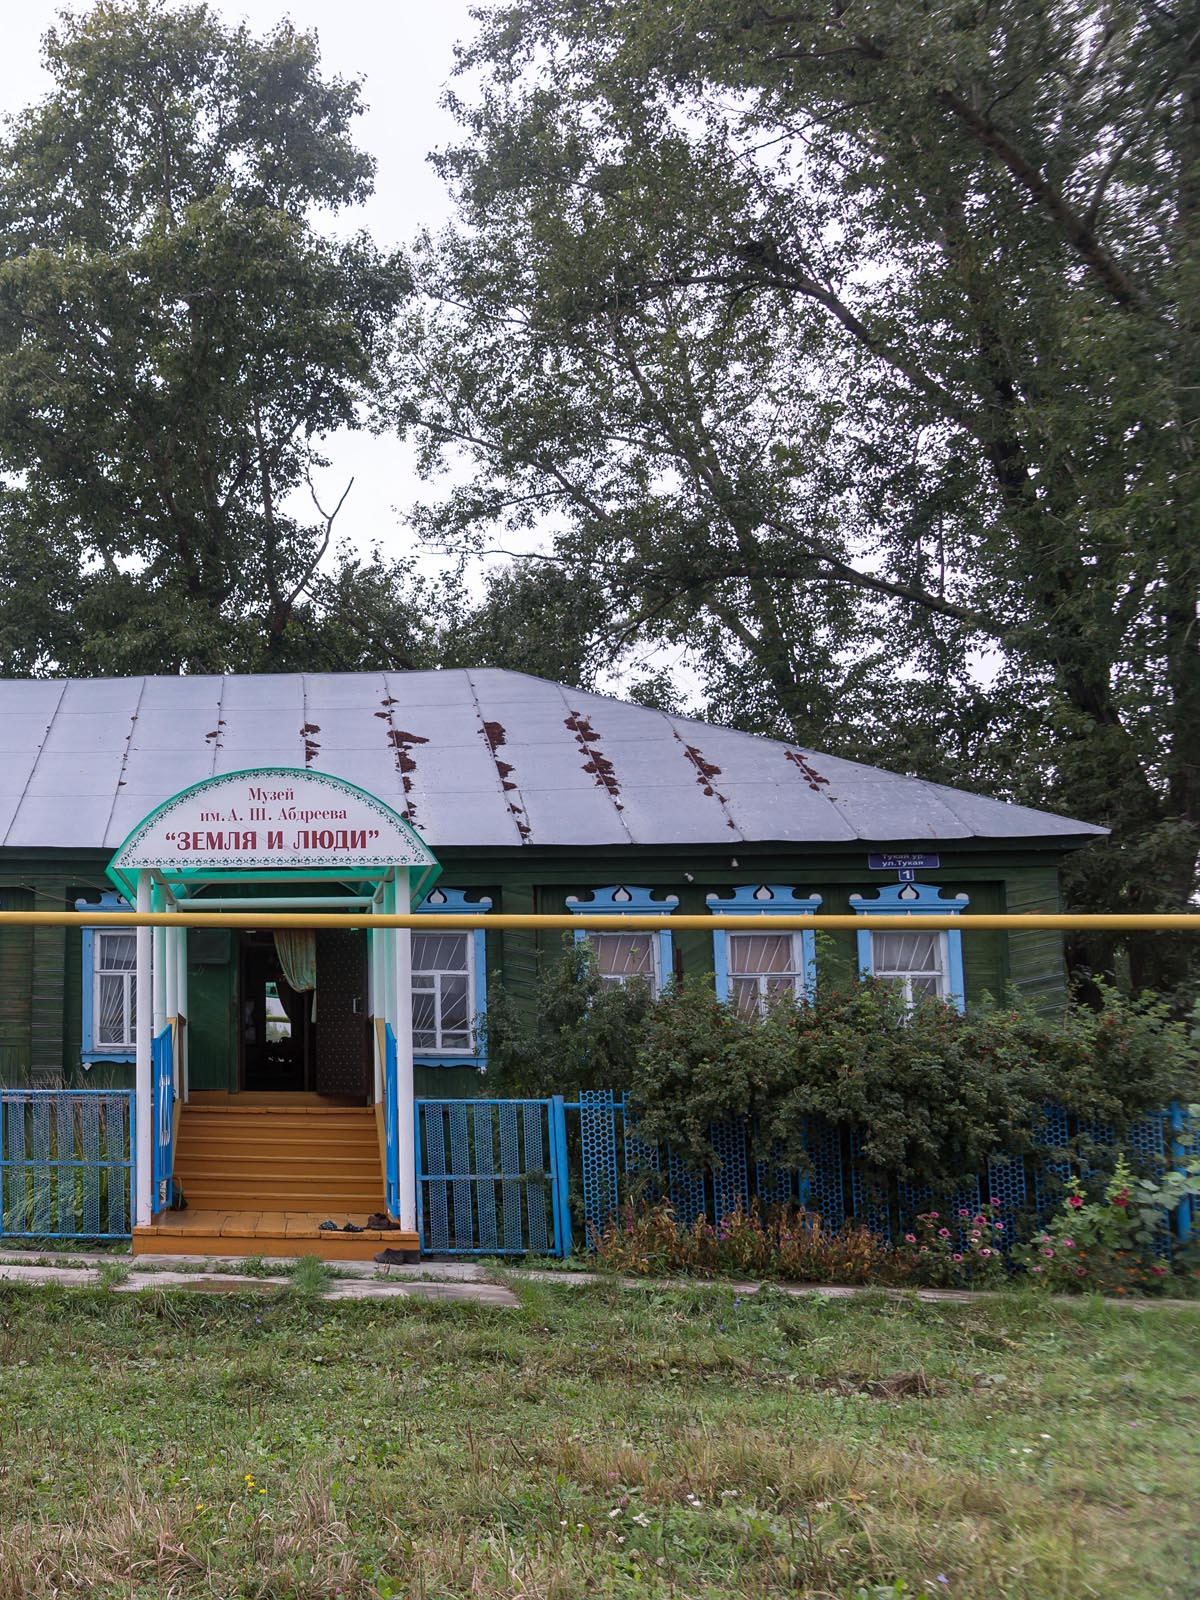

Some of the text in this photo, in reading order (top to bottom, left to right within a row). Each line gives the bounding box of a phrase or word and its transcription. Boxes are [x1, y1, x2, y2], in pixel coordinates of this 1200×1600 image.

[248, 787, 294, 804] Музей
[250, 808, 272, 822] Ш.
[279, 807, 347, 823] Абдреева
[165, 830, 379, 851] “ЗЕМЛЯ И ЛЮДИ”
[903, 870, 911, 879] 1
